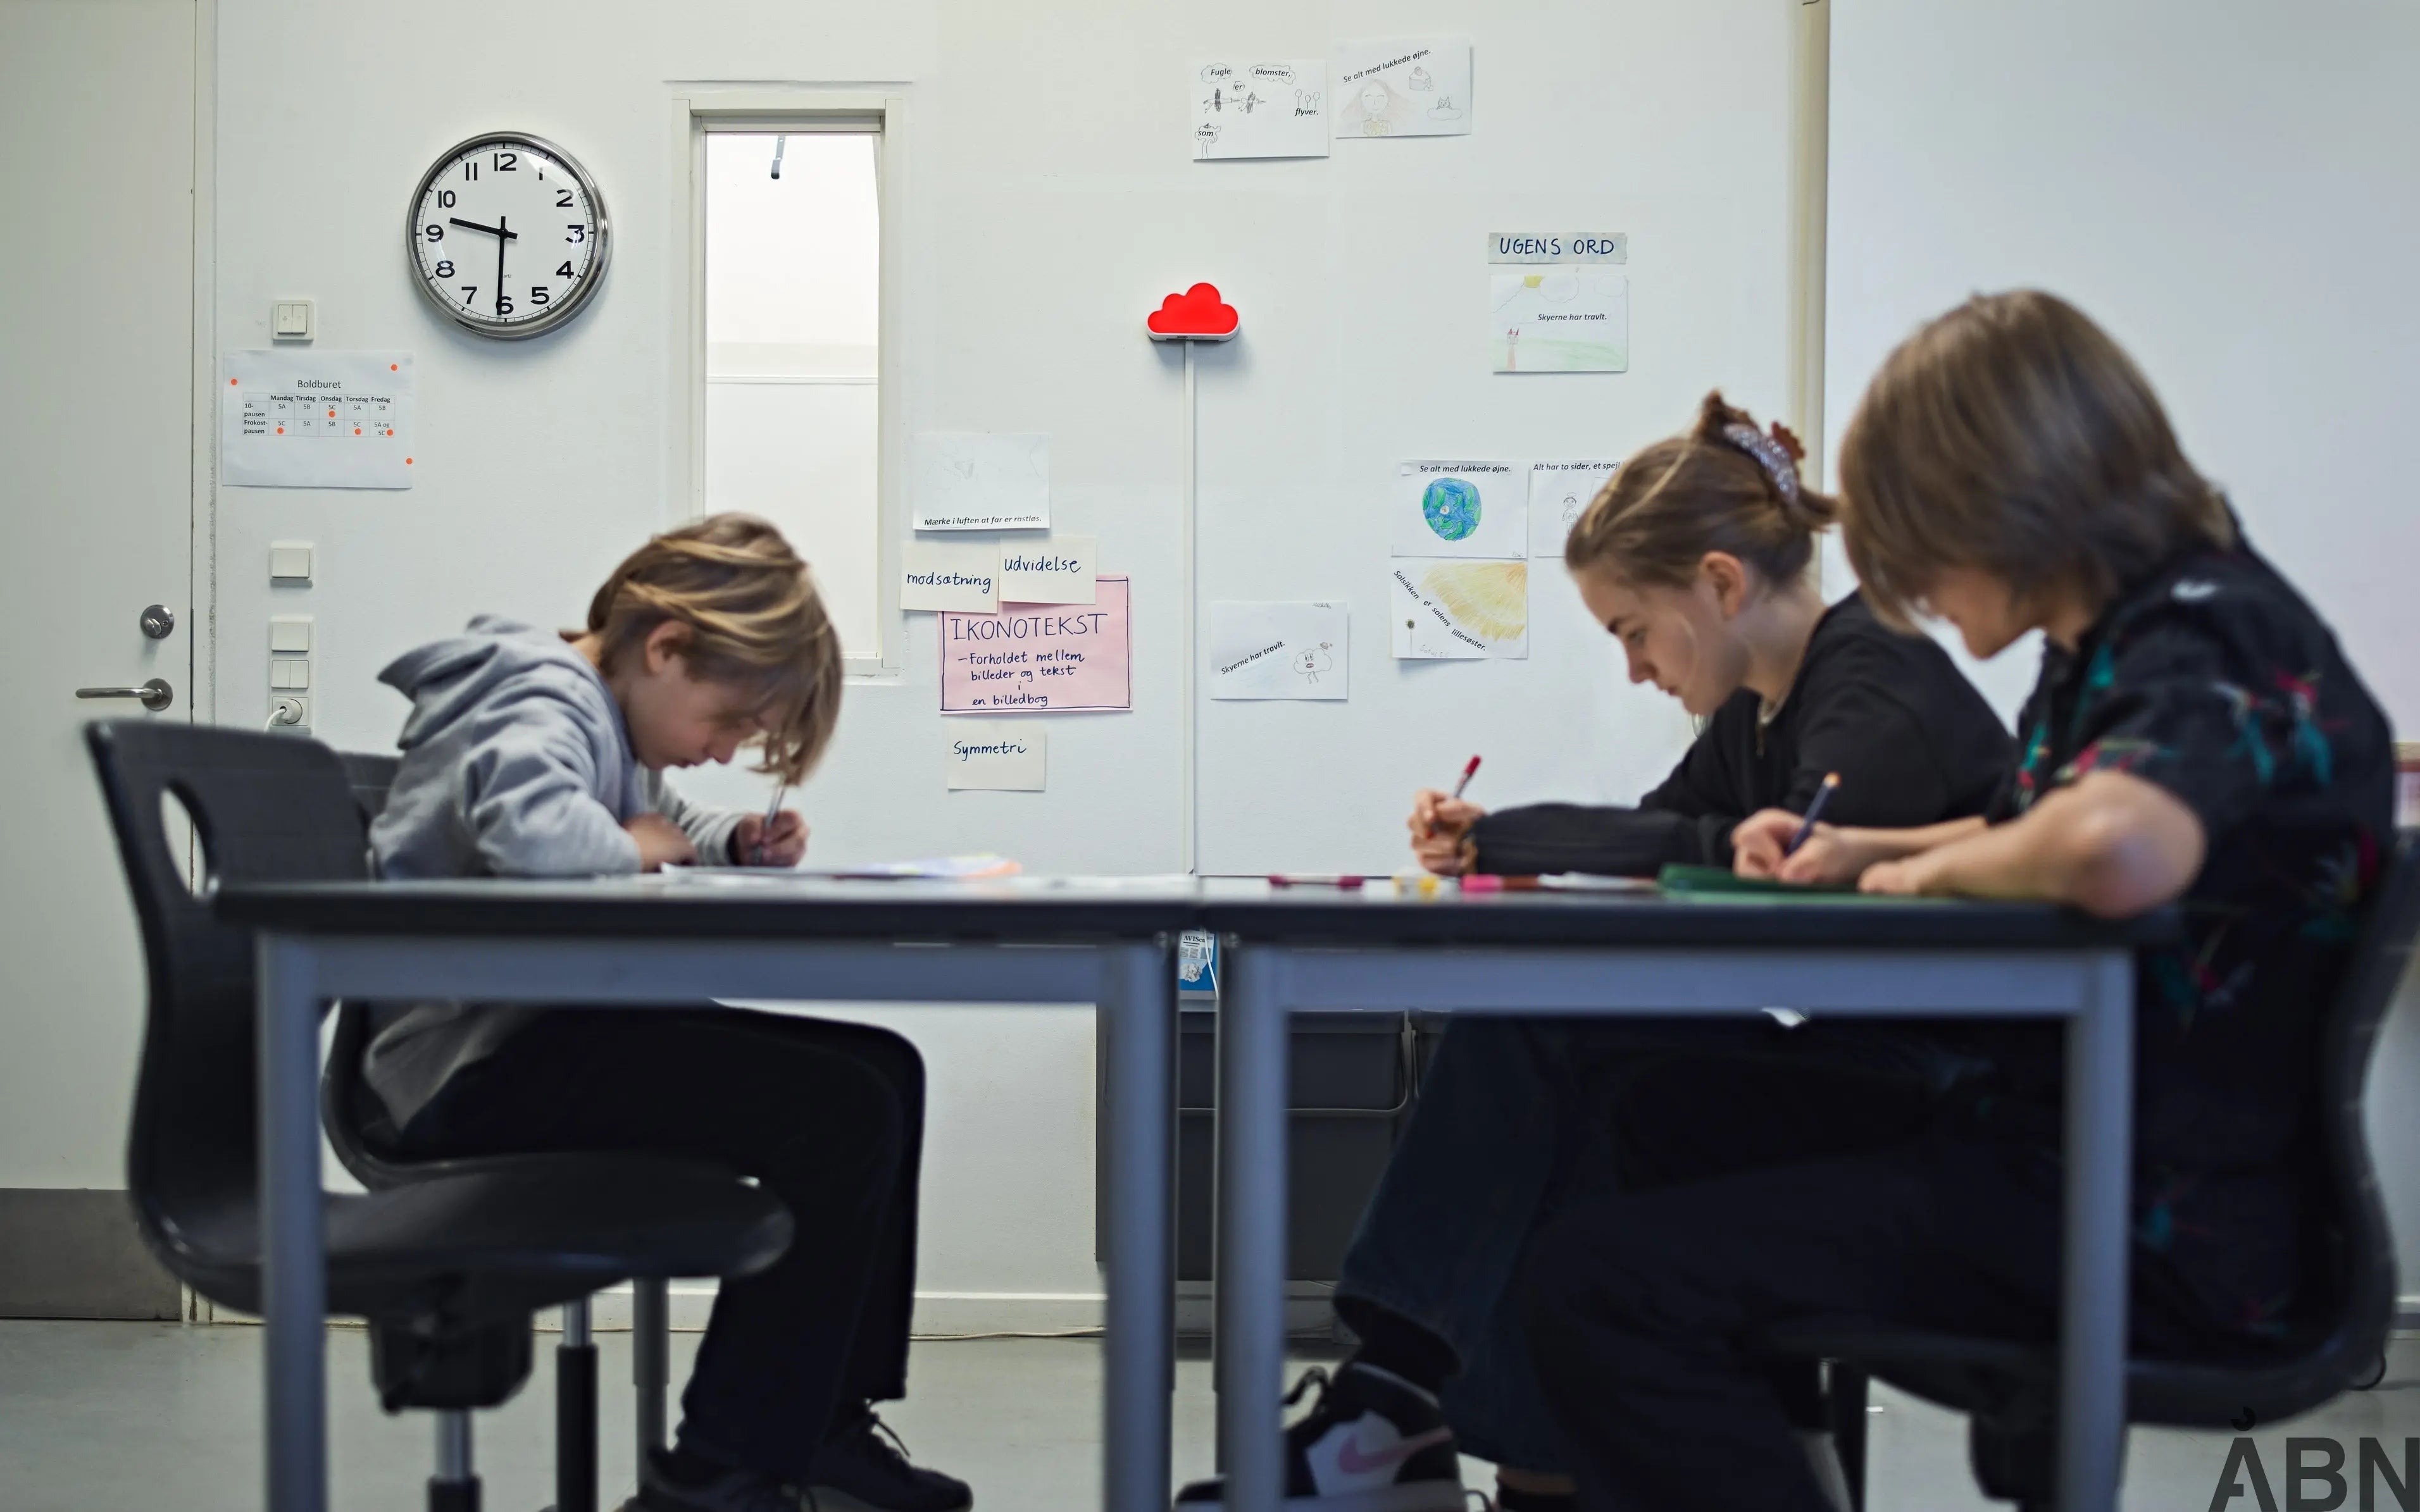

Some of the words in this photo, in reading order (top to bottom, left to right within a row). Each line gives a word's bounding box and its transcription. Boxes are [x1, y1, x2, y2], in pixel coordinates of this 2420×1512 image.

[1211, 68, 1231, 77] Fugle
[1256, 68, 1291, 77] blomster,
[1343, 75, 1354, 84] Se
[1354, 70, 1364, 80] alt
[1365, 65, 1381, 77] med
[1382, 54, 1411, 70] lukkede
[1413, 49, 1431, 63] øjne.
[1295, 108, 1319, 116] flyver.
[494, 153, 517, 171] 12
[465, 163, 478, 180] 11
[438, 190, 456, 208] 10
[556, 189, 573, 207] 2
[425, 224, 444, 242] 9
[565, 225, 585, 244] 3
[1500, 237, 1561, 255] UGENS
[1573, 239, 1614, 254] ORD
[435, 260, 455, 278] 8
[556, 261, 574, 279] 4
[461, 286, 477, 304] 7
[530, 287, 550, 305] 5
[496, 296, 514, 314] 6
[1538, 314, 1567, 322] Skyerne
[297, 380, 341, 388] Boldburet
[1461, 464, 1490, 473] lukkede
[1492, 465, 1511, 474] øjne.
[1004, 555, 1081, 573] udvidelse
[1394, 570, 1419, 600] Solsikken
[1431, 606, 1450, 628] solens
[1452, 628, 1486, 651] lillesøster.
[951, 613, 1108, 641] IKONOTEKST
[1036, 649, 1085, 662] mellem
[1221, 657, 1249, 674] Skyerne
[1250, 652, 1262, 662] har
[1264, 641, 1285, 655] travlt.
[971, 671, 1015, 681] billeder
[1021, 671, 1033, 682] og
[1040, 665, 1076, 676] tekst
[1018, 681, 1021, 690] i
[994, 693, 1048, 707] billedbog
[953, 738, 1027, 762] Symmetri
